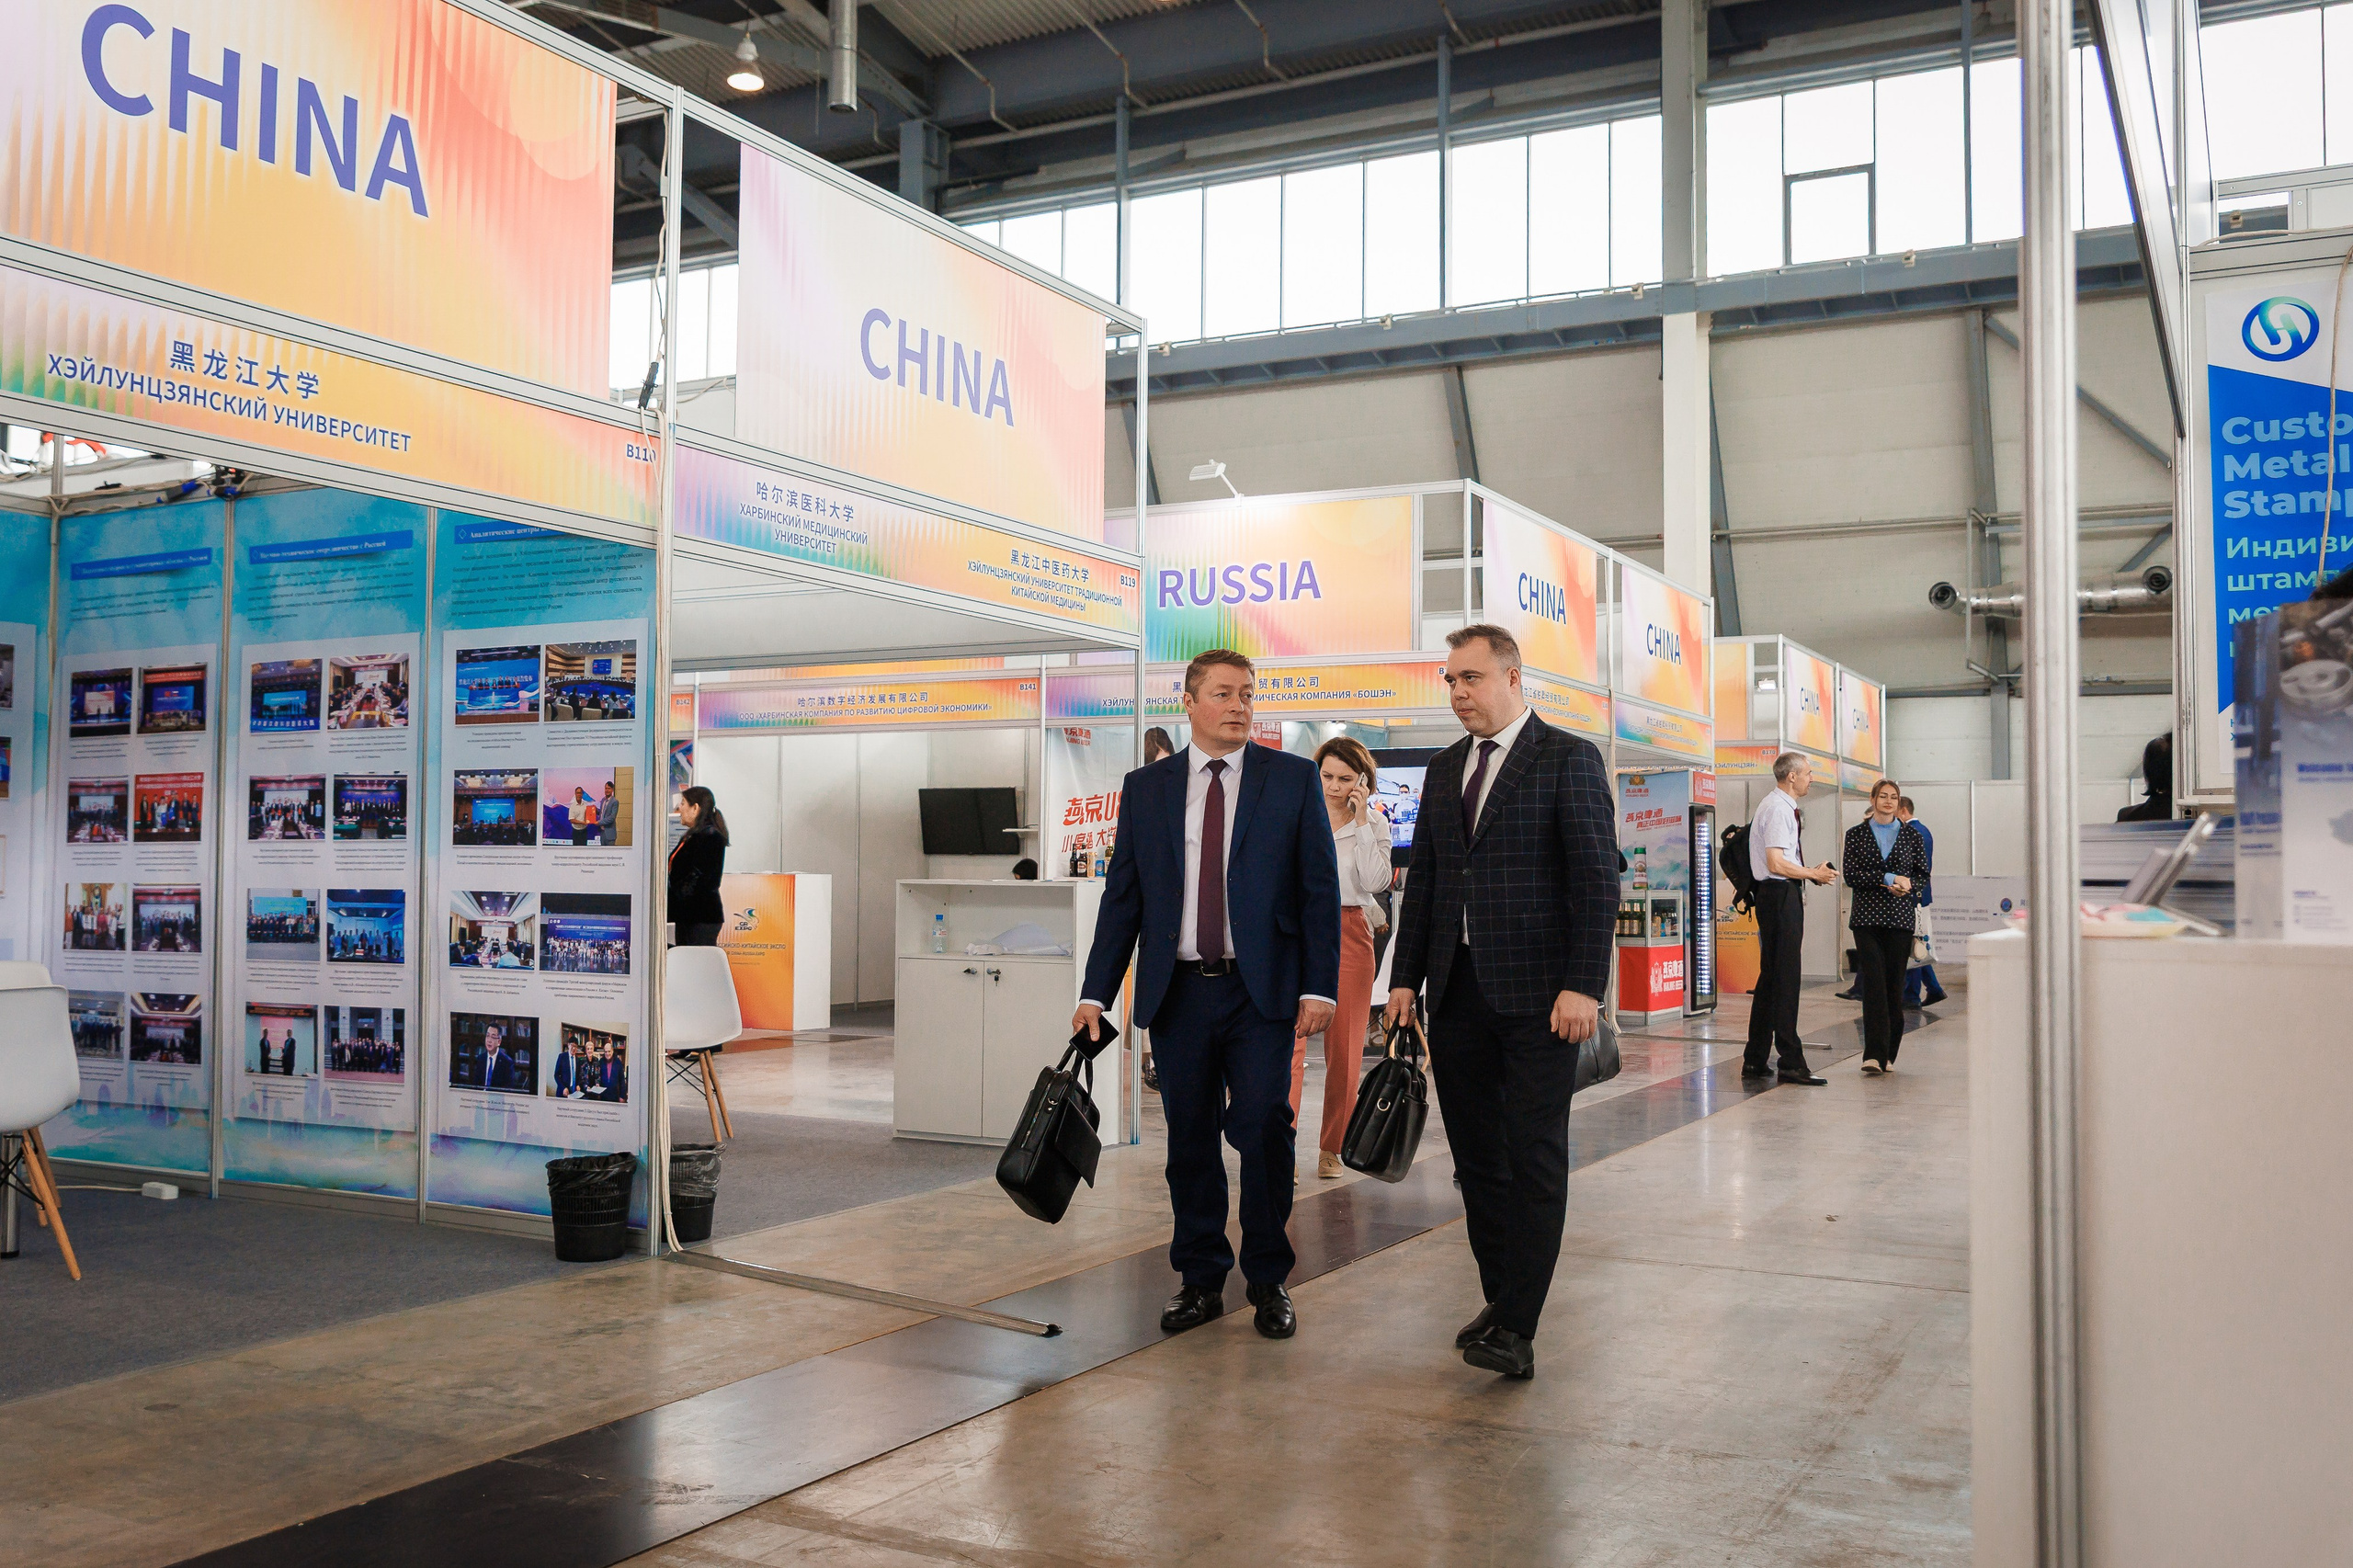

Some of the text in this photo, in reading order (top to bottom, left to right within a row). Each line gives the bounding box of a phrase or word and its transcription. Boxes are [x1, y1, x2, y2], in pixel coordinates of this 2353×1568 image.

[81, 4, 429, 218] CHINA
[170, 340, 320, 400] 黑龙江大学
[860, 308, 1014, 427] CHINA
[48, 354, 412, 452] ХЭЙЛУНЦЗЯНСКИЙ УНИВЕРСИТЕТ
[2222, 412, 2353, 445] Custo
[2223, 443, 2350, 482] Metal
[756, 482, 854, 522] 哈尔滨医科大学
[740, 503, 868, 545] ХАРБИНСКИЙ МЕДИЦИНСКИЙ
[775, 528, 836, 553] УНИВЕРСИТЕТ
[968, 561, 1122, 607] ХЭЙЛУНЦЗЯНСКИЙ УНИВЕРСИТЕТ ТРАДИЦИОННОЙ
[1011, 549, 1089, 583] 黑龙江中医药大学
[1120, 574, 1136, 587] B119
[1159, 561, 1322, 608] RUSSIA
[1011, 585, 1086, 611] КИТАЙСКОЙ МЕДИЦИНЫ
[1518, 572, 1566, 625] CHINA
[1646, 623, 1681, 665] CHINA
[798, 692, 928, 707] 哈尔滨数字经济发展有限公司
[804, 710, 843, 718] КОМПАНИЯ
[856, 707, 896, 716] РАЗВИТИЮ
[897, 703, 939, 715] ЦИФРОВОЙ
[1103, 697, 1178, 707] ХЭЙЛУНЯНСКАЯ
[1301, 690, 1351, 700] КОМПАНИЯ
[1353, 689, 1397, 699] «БОШЭН»
[1800, 687, 1820, 716] CHINA
